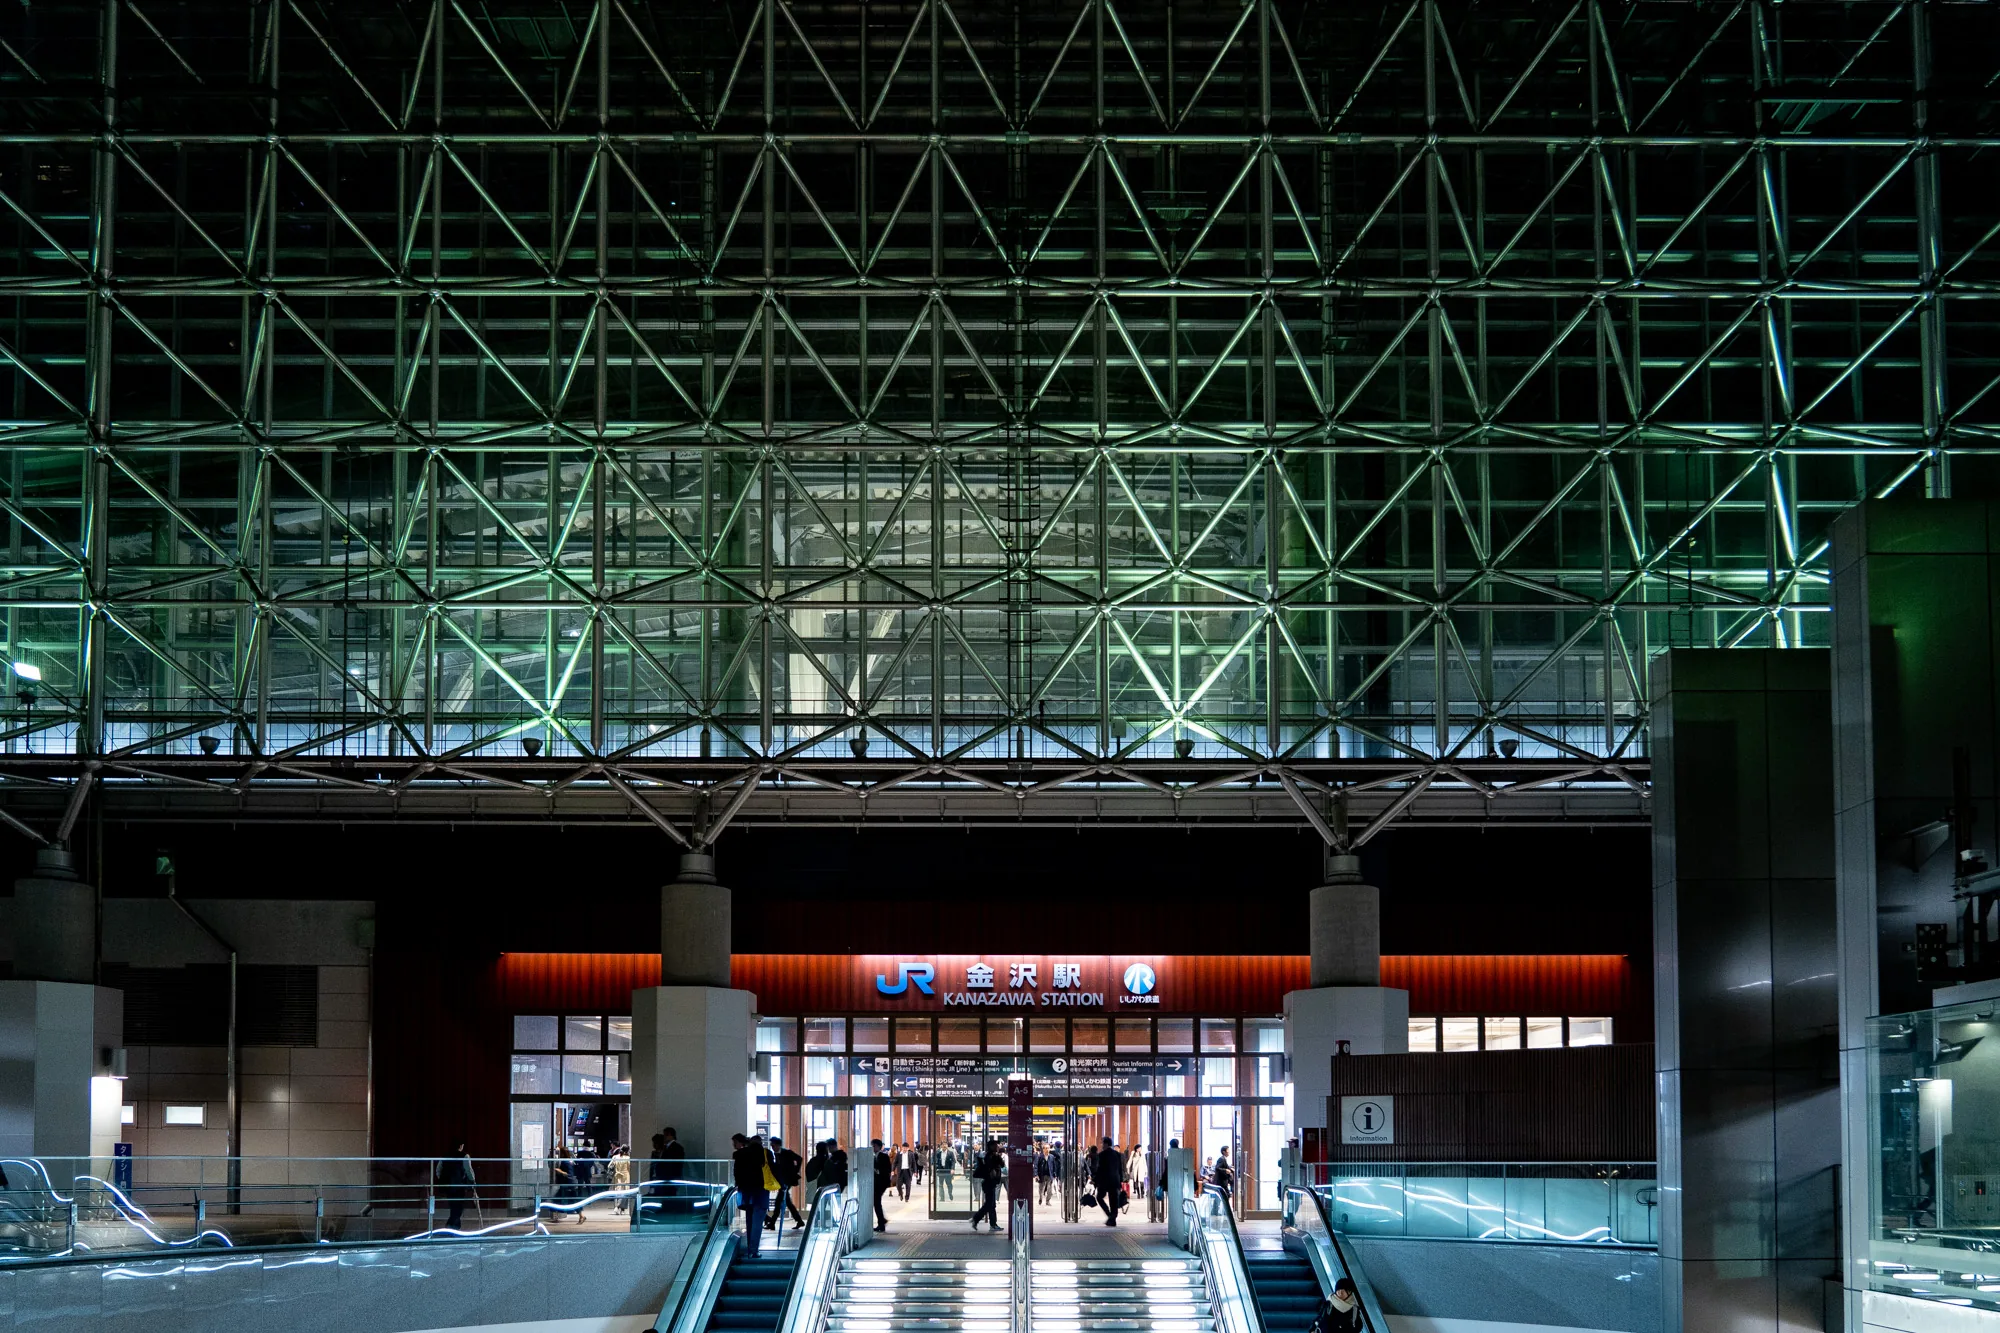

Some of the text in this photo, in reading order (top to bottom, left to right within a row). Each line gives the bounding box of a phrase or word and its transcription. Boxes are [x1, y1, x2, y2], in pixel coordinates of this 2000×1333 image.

[876, 962, 935, 995] JR
[966, 962, 1081, 989] 金沢駅
[943, 992, 1104, 1006] KANAZAWA STATION
[877, 1078, 885, 1088] 3
[1013, 1086, 1028, 1094] A-5
